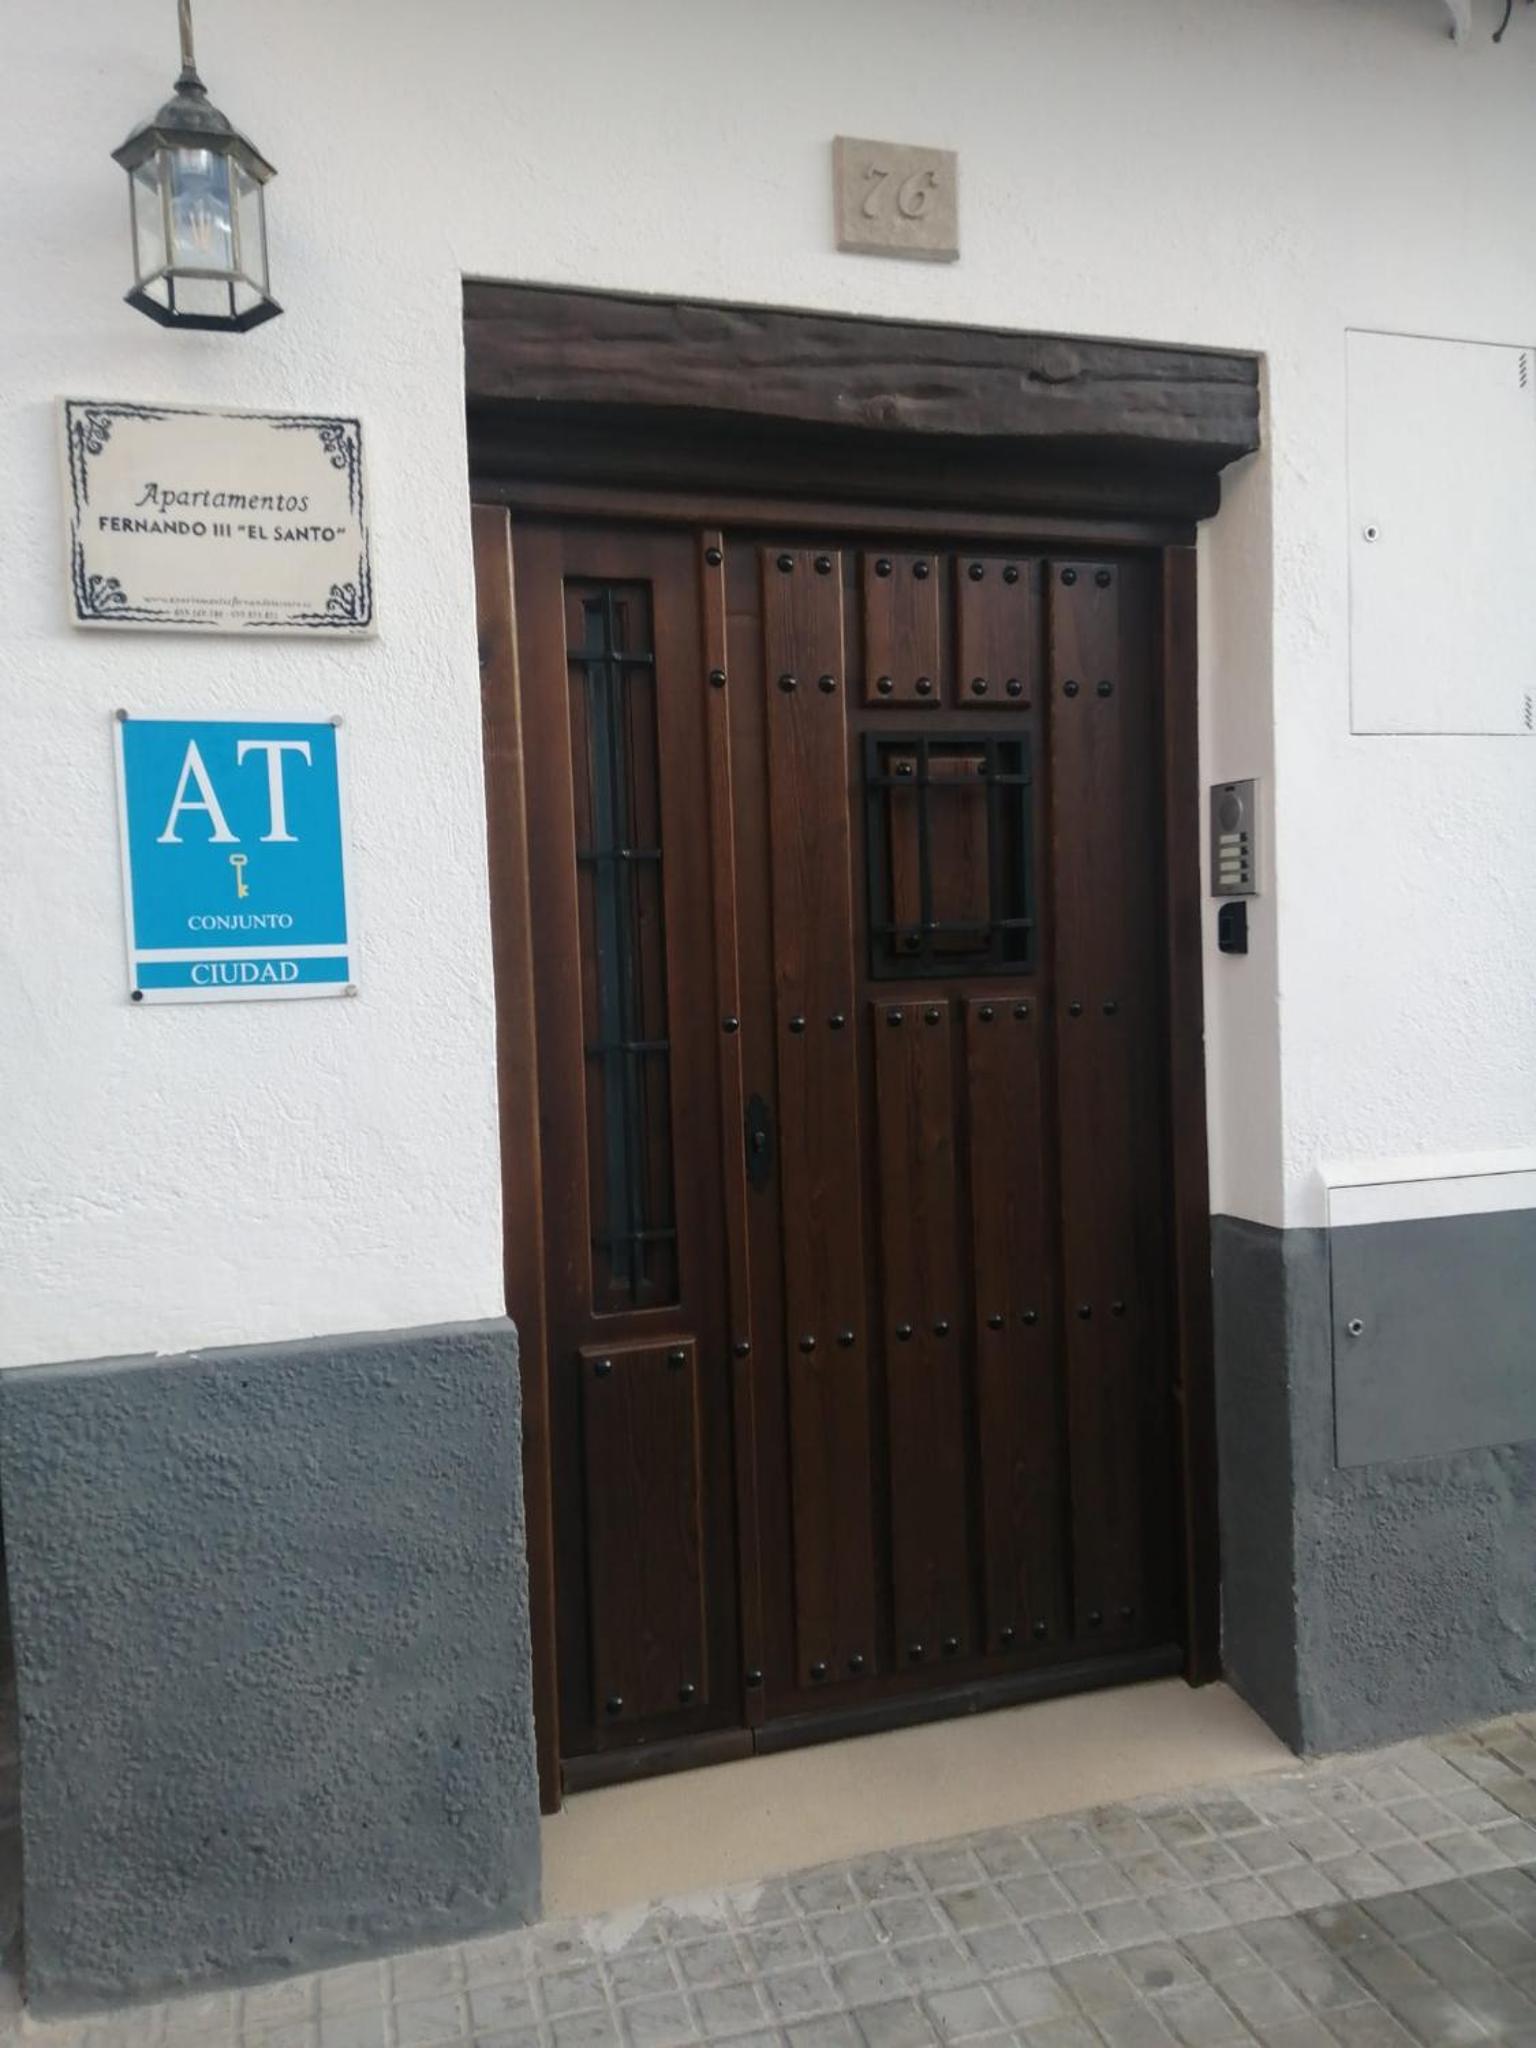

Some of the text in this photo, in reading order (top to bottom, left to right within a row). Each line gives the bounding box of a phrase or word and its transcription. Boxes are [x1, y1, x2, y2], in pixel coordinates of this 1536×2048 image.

[861, 164, 939, 221] 76
[135, 482, 309, 513] Apartamentos
[98, 516, 207, 537] FERNANDO
[212, 523, 232, 538] III
[156, 738, 313, 844] AT
[187, 913, 294, 932] CONJUNTO
[190, 960, 300, 985] CIUDAD
